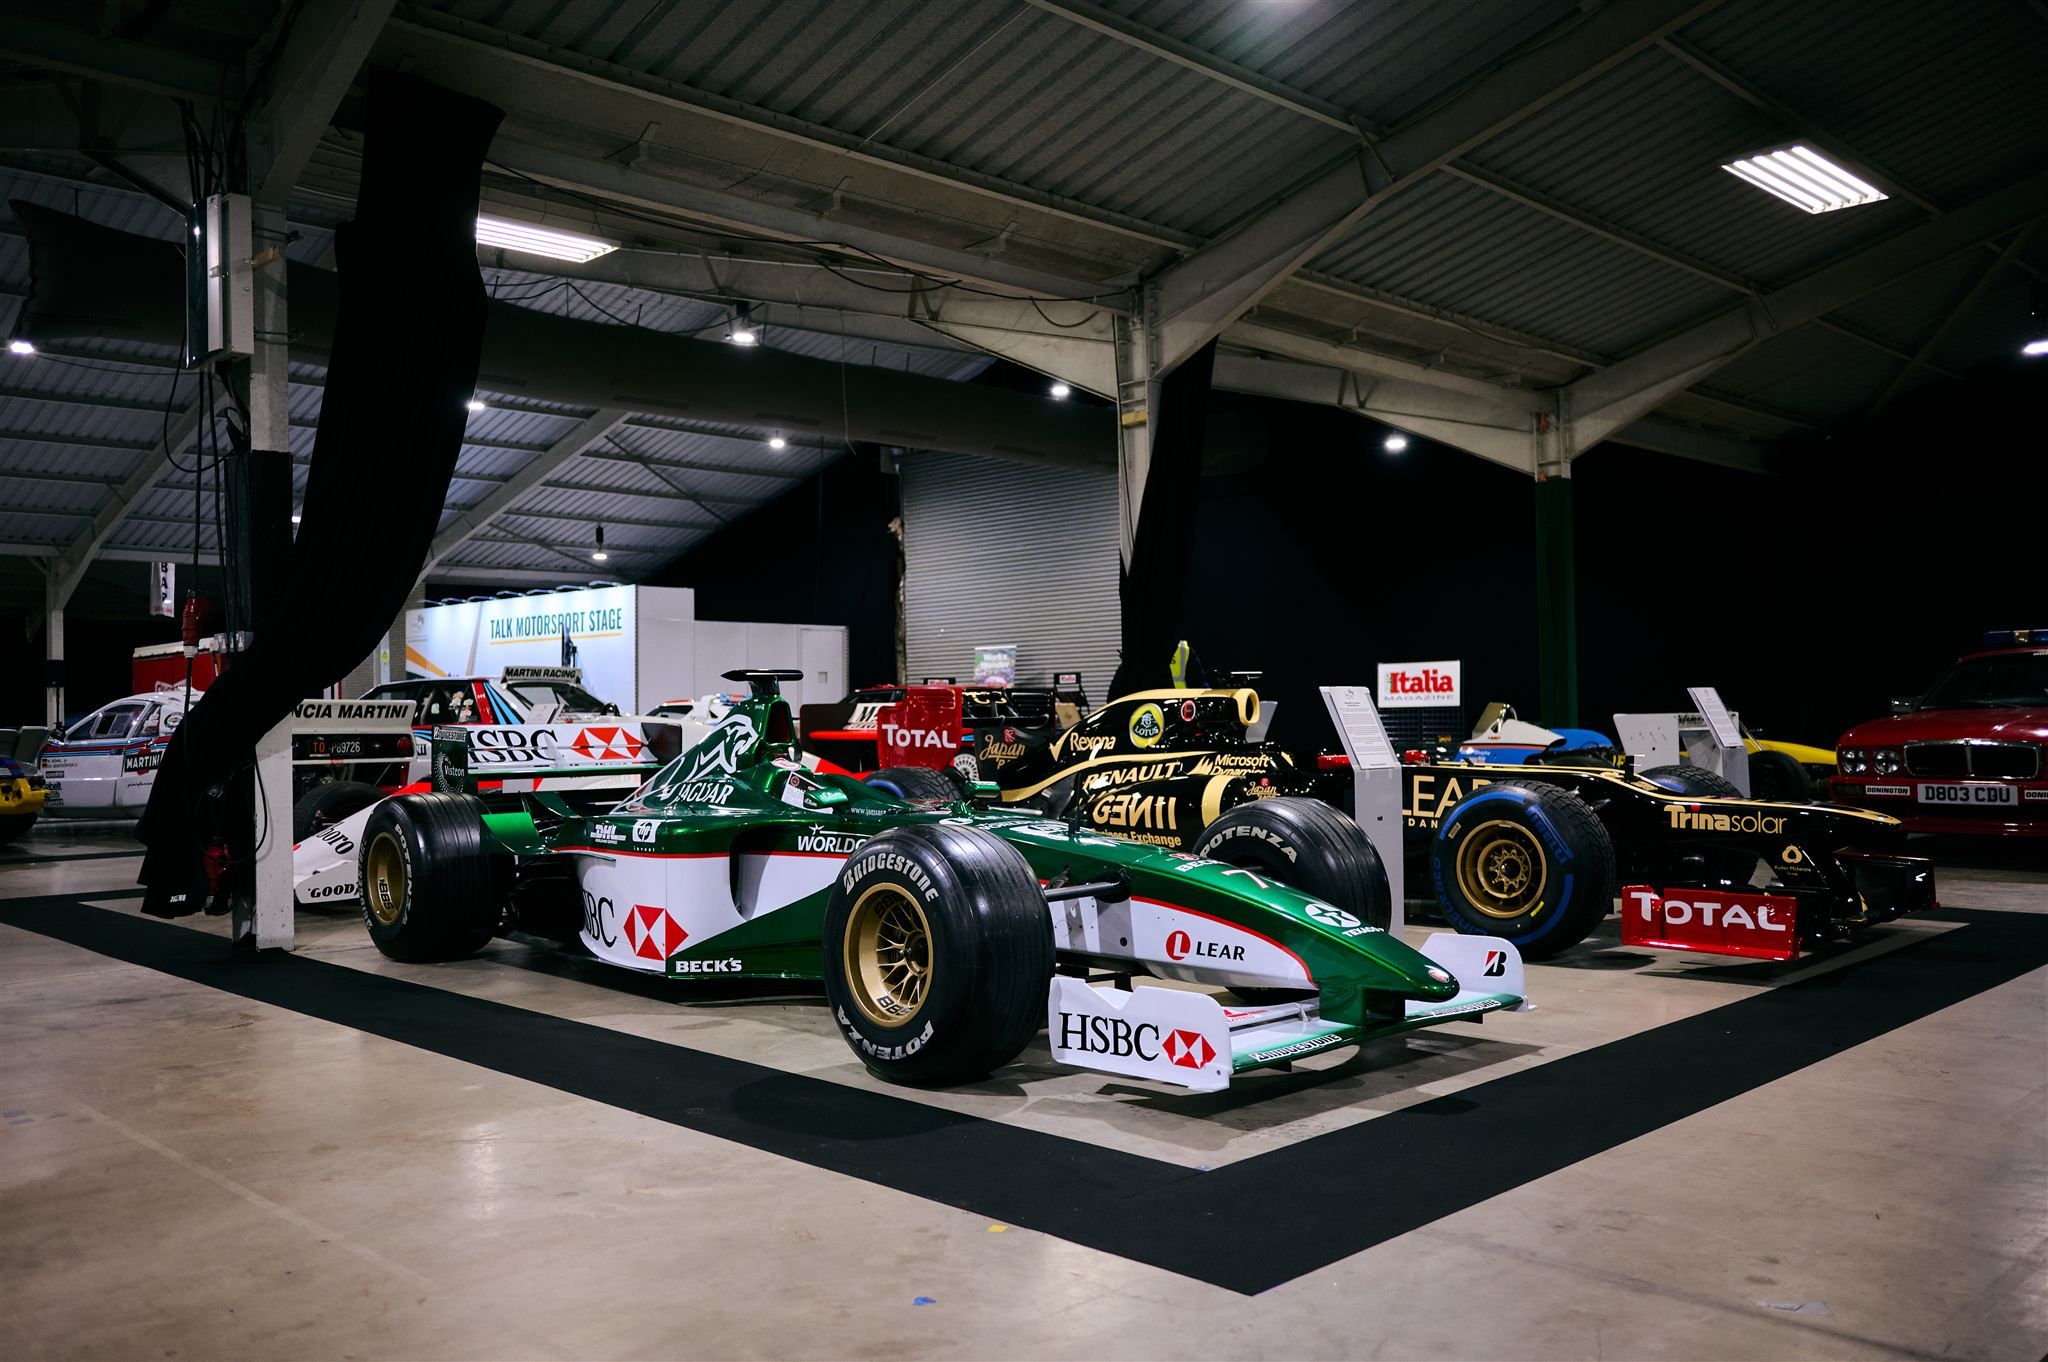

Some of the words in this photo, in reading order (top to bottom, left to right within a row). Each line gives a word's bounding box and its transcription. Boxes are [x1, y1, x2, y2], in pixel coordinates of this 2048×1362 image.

[490, 618, 513, 639] TALK
[516, 612, 585, 637] MOTORSPORT
[589, 608, 622, 632] STAGE
[505, 667, 541, 678] MARTINI
[543, 668, 576, 678] RACING
[1390, 669, 1453, 693] Italia
[292, 704, 332, 718] NCIA
[337, 704, 409, 718] MARTINI
[882, 724, 956, 748] TOTAL
[1134, 723, 1159, 737] LOTUS
[980, 735, 1025, 762] Japan
[1070, 732, 1116, 751] Rexona
[445, 765, 464, 776] Visteon
[1214, 754, 1269, 767] Microsoft
[1083, 762, 1180, 790] RENAULT
[668, 783, 734, 805] JAGUAR
[1866, 786, 1909, 795] DONINGTON
[1925, 785, 1970, 802] D803
[1408, 818, 1438, 829] DAN
[316, 822, 354, 855] boro
[798, 835, 867, 853] WORLDC
[1130, 831, 1182, 848] Exchange
[1201, 826, 1298, 864] POTENZA
[843, 853, 939, 902] BRIDGESTONE
[379, 883, 394, 910] BBS
[584, 889, 617, 947] BC
[1630, 891, 1786, 932] TOTAL
[1196, 941, 1245, 961] LEAR
[675, 957, 742, 973] BECK'S
[838, 1005, 934, 1060] POTENZA
[1058, 1012, 1160, 1062] HSBC
